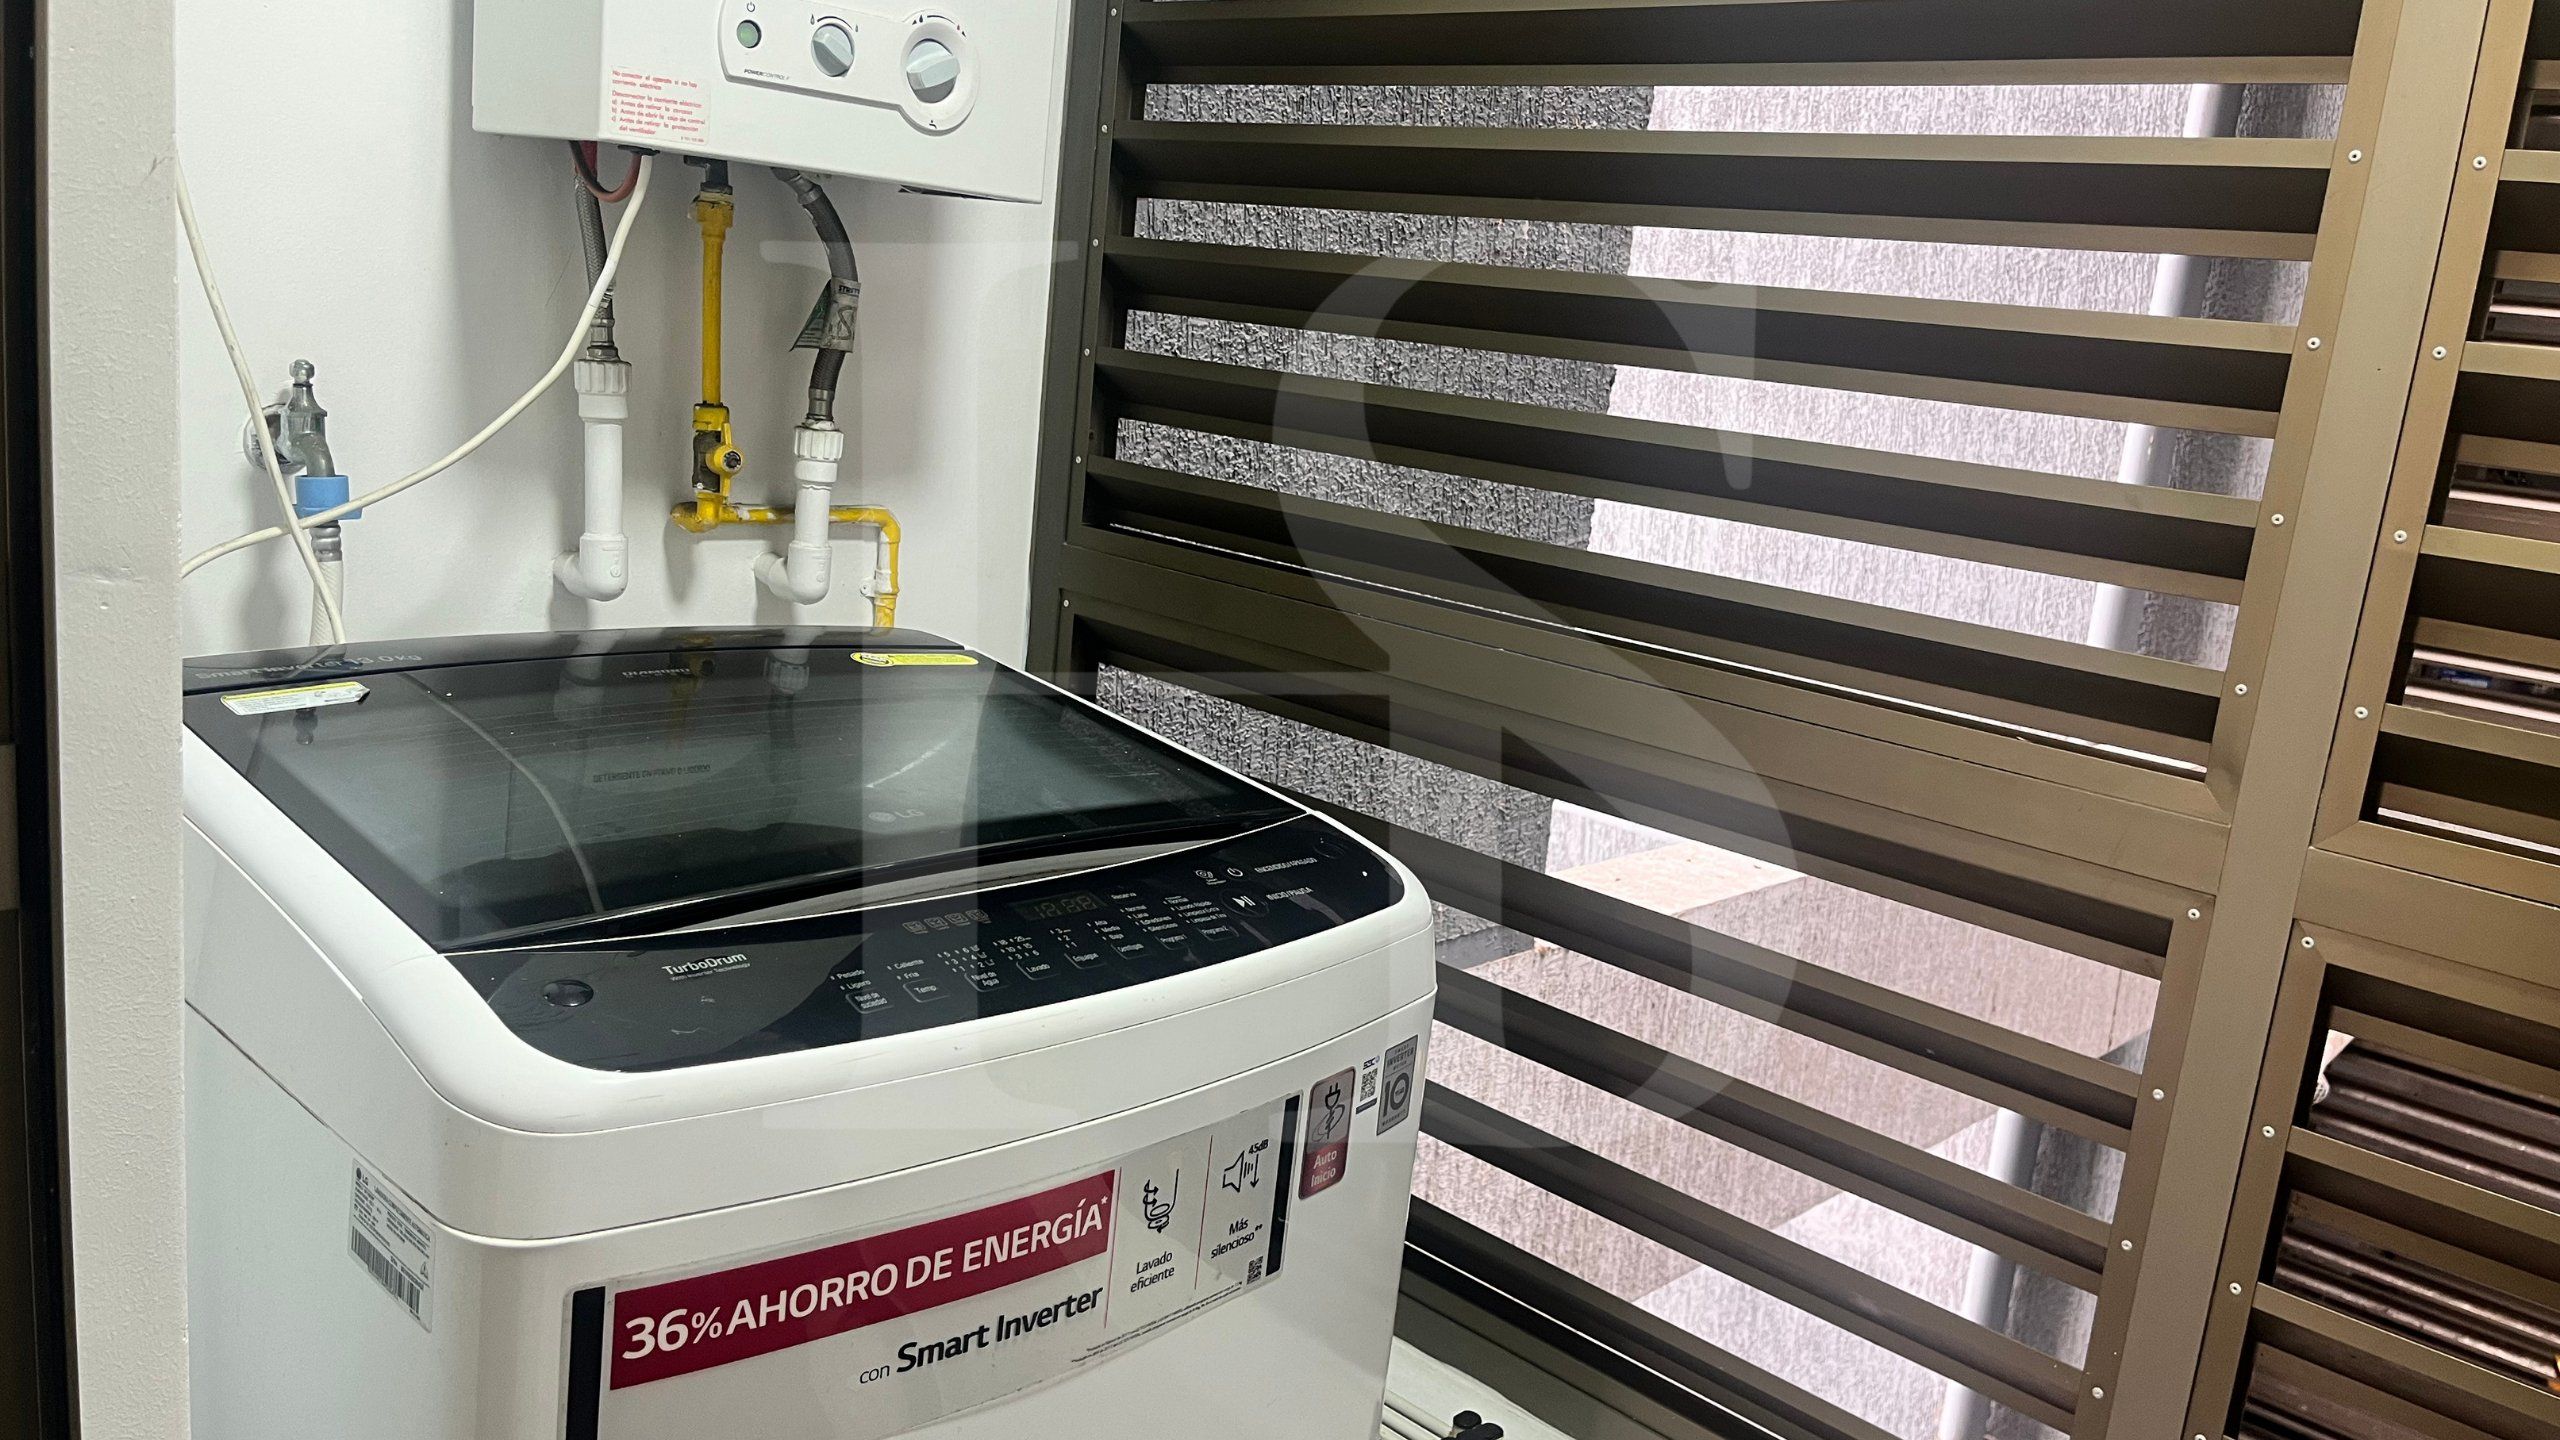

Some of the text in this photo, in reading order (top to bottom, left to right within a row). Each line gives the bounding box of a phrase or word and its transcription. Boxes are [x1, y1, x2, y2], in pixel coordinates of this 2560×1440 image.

[894, 809, 925, 818] LG
[661, 953, 747, 975] TurboDrum
[1383, 1072, 1410, 1118] 10
[1248, 1139, 1269, 1155] 45dB
[1313, 1150, 1337, 1169] Auto
[1310, 1166, 1336, 1187] Inicio
[1228, 1217, 1249, 1236] Más
[1136, 1251, 1173, 1275] Lavado
[1130, 1266, 1175, 1293] eficiente
[621, 1305, 723, 1361] 36%
[725, 1262, 899, 1337] AHORRO
[905, 1246, 955, 1290] DE
[859, 1363, 890, 1385] con
[896, 1325, 990, 1373] Smart
[996, 1286, 1104, 1343] Inverter
